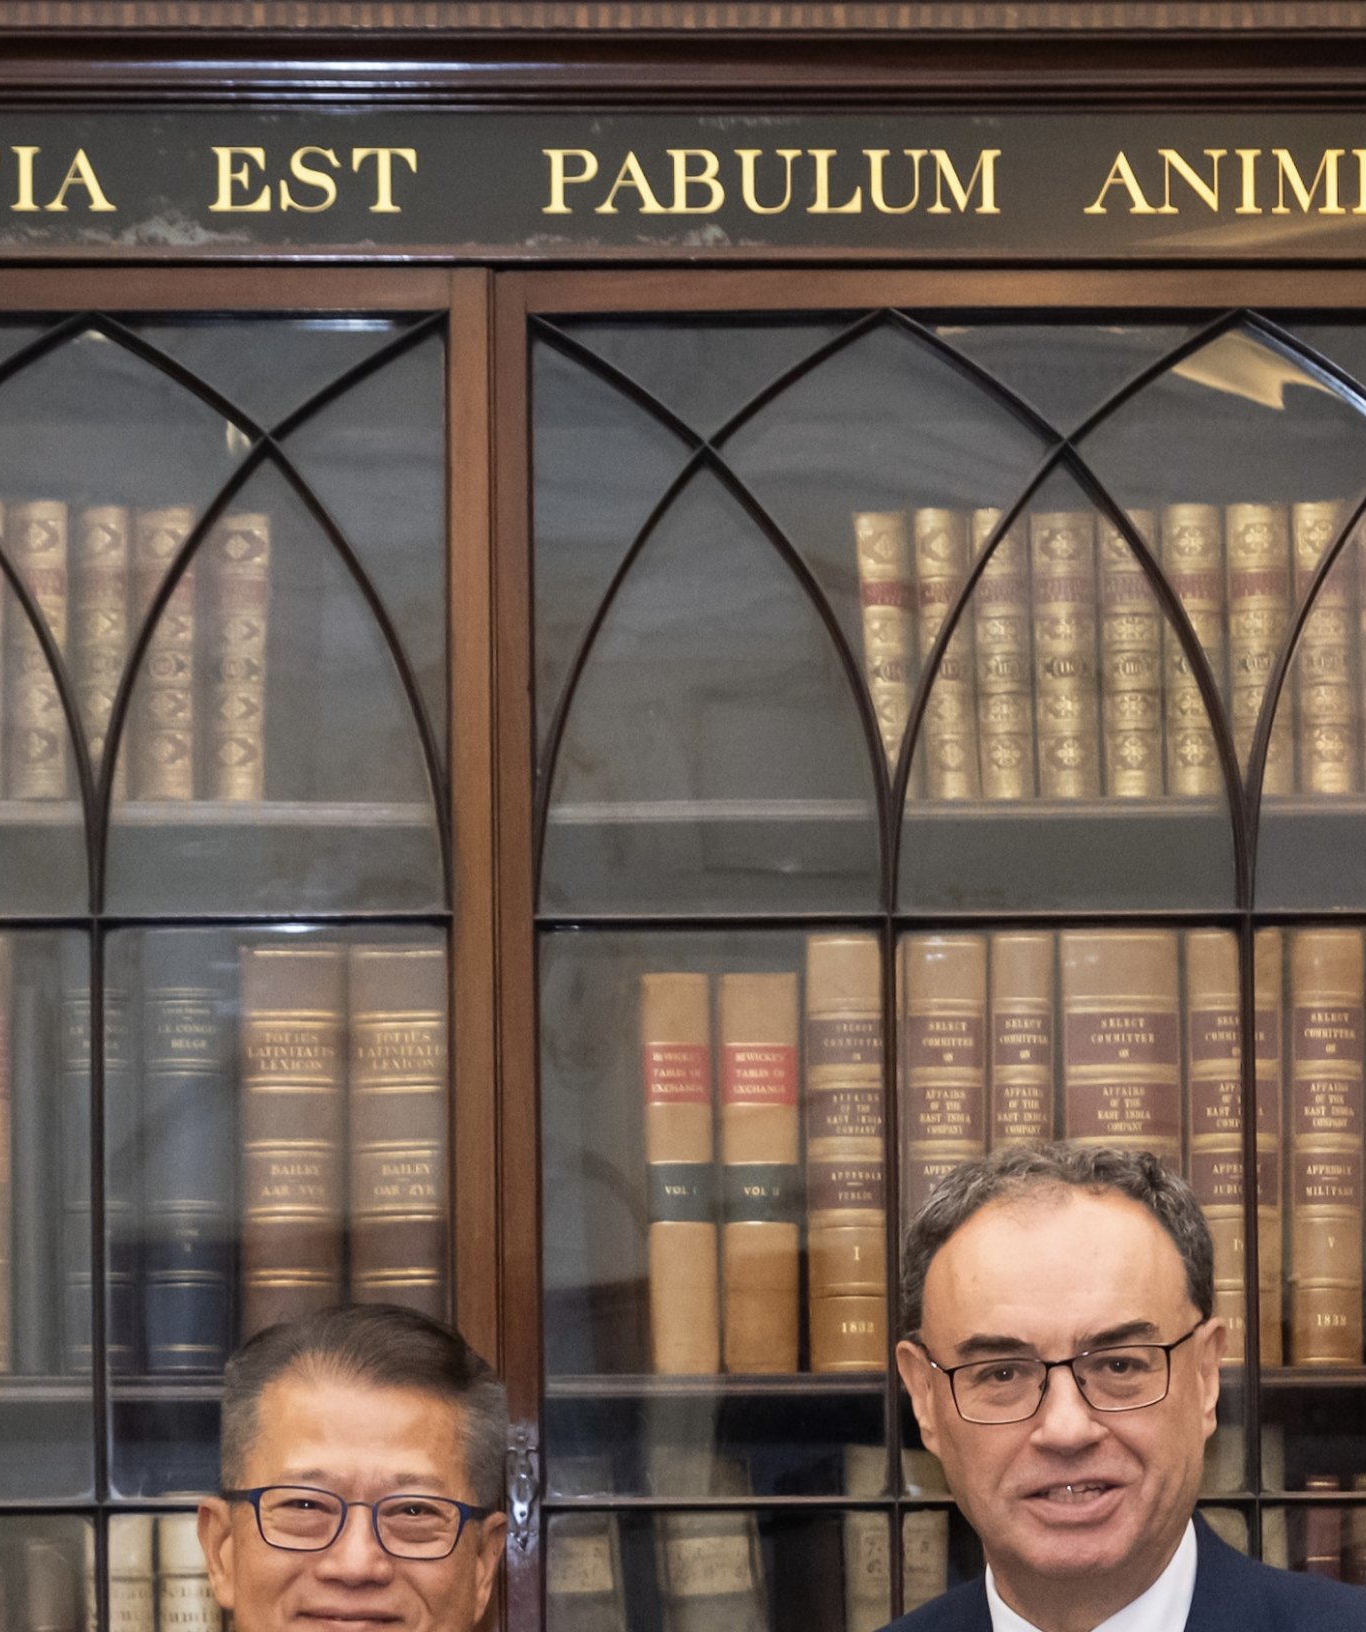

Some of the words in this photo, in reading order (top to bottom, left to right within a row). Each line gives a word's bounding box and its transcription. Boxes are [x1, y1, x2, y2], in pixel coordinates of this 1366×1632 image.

[208, 145, 418, 213] EST
[541, 148, 1002, 214] PABULUM
[1100, 1017, 1146, 1029] SELECT
[1310, 1012, 1350, 1023] SELECT
[928, 1022, 968, 1032] SELECT
[1004, 1018, 1042, 1029] SELECT
[265, 1032, 319, 1044] TOTIUS
[376, 1032, 431, 1044] TOTIUS
[999, 1034, 1049, 1044] COMMITTEE
[1090, 1032, 1155, 1043] COMMITTEE
[1304, 1028, 1356, 1039] COMMITTEE
[922, 1037, 974, 1048] COMMITTEE
[1019, 1049, 1031, 1060] ON
[1118, 1048, 1130, 1058] ON
[260, 1060, 323, 1071] LEXICON
[372, 1059, 435, 1071] LEXICON
[1004, 1087, 1044, 1097] AFFAIRS
[1102, 1086, 1146, 1096] AFFAIRS
[1310, 1082, 1349, 1093] AFFAIRS
[925, 1089, 966, 1099] AFFAIRS
[1315, 1094, 1324, 1104] OF
[1328, 1094, 1345, 1105] THE
[930, 1101, 939, 1111] OF
[945, 1101, 961, 1111] THE
[1008, 1099, 1018, 1109] OF
[1022, 1099, 1040, 1110] THE
[1109, 1098, 1119, 1108] OF
[1124, 1098, 1142, 1107] THE
[857, 1105, 871, 1115] THE
[997, 1110, 1018, 1121] EAST
[1023, 1110, 1047, 1121] INDIA
[1097, 1109, 1119, 1120] EAST
[1125, 1109, 1151, 1120] INDIA
[1206, 1107, 1230, 1117] EAST
[1304, 1106, 1326, 1117] EAST
[1331, 1106, 1354, 1117] INDIA
[826, 1116, 849, 1126] EAST
[919, 1113, 942, 1124] EAST
[947, 1113, 972, 1124] INDIA
[1312, 1118, 1348, 1129] COMPANY
[836, 1126, 876, 1136] COMPANY
[926, 1124, 963, 1135] COMPANY
[1005, 1124, 1041, 1135] COMPANY
[1106, 1121, 1143, 1132] COMPANY
[271, 1164, 320, 1176] BAILEY
[382, 1163, 431, 1176] BAILEY
[1306, 1164, 1352, 1176] APPENDIX
[1306, 1185, 1353, 1197] MILITARY
[1327, 1236, 1336, 1249] V
[1317, 1313, 1347, 1326] 1832
[841, 1321, 875, 1333] 1832
